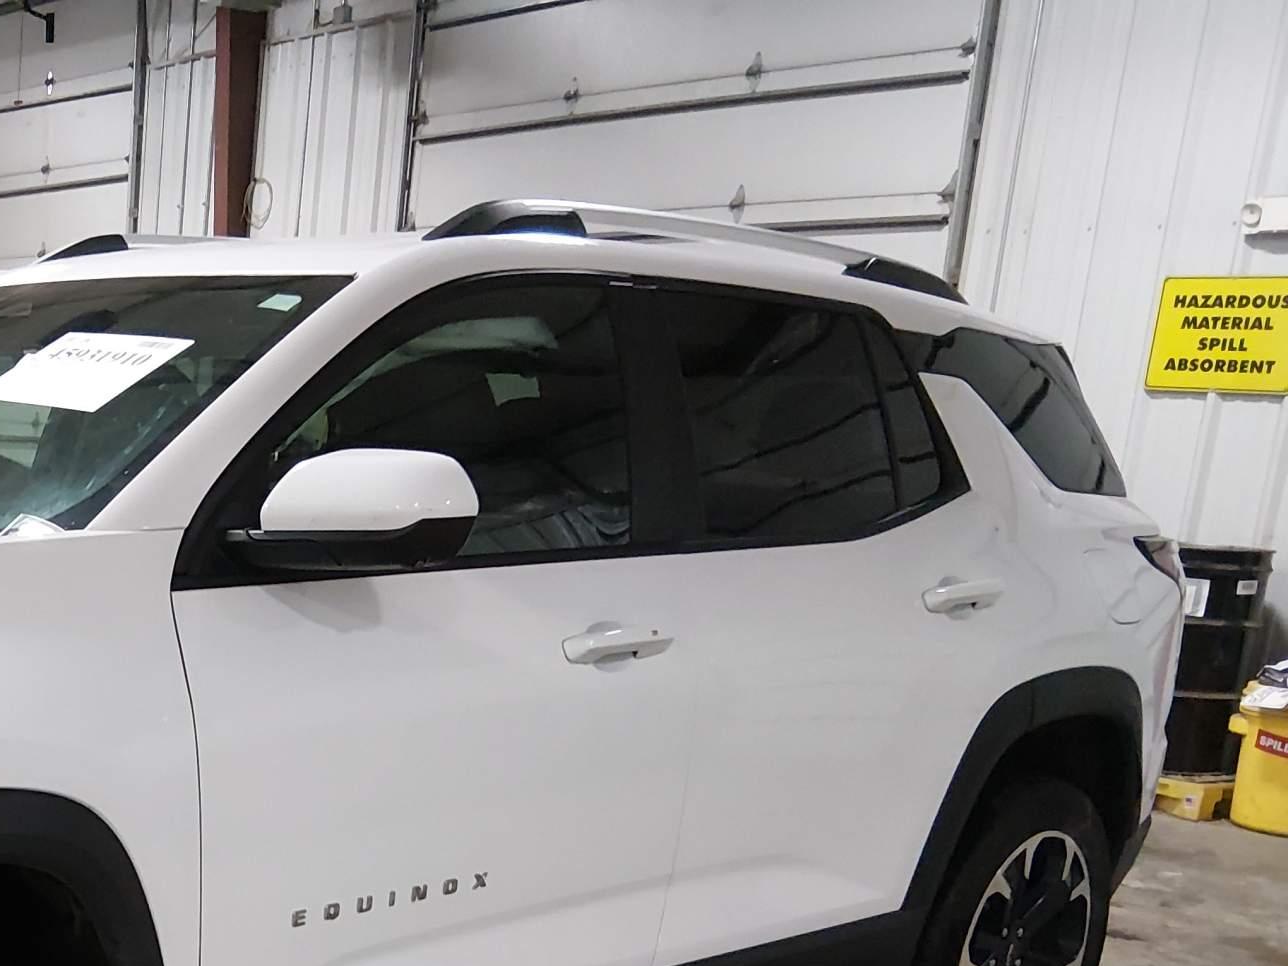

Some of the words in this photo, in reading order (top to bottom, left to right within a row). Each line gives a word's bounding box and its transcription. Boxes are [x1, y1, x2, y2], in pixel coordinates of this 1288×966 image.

[1174, 294, 1288, 309] HAZARDOUS
[1181, 316, 1274, 331] MATERIAL
[1197, 337, 1248, 352] SPILL
[1164, 358, 1276, 374] ABSORBENT
[291, 871, 489, 928] EQUINOX
